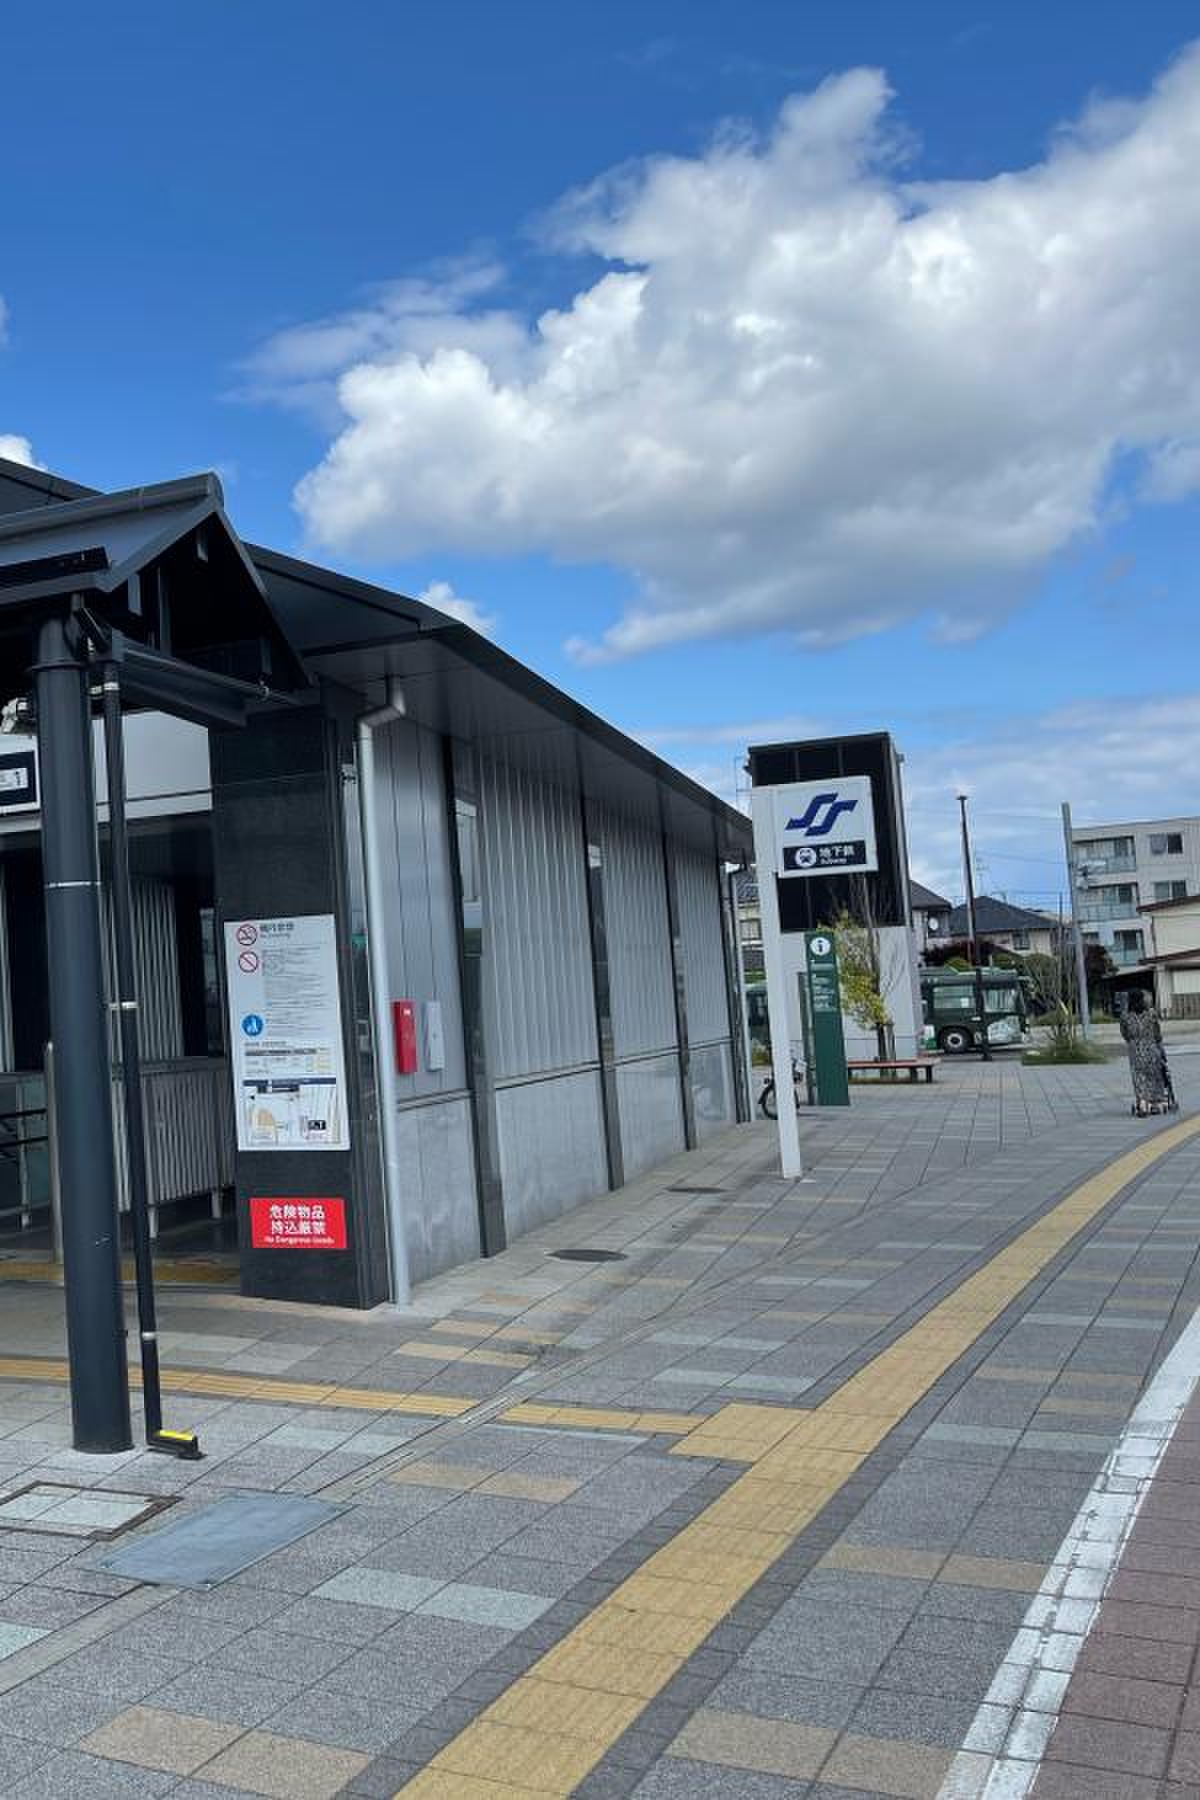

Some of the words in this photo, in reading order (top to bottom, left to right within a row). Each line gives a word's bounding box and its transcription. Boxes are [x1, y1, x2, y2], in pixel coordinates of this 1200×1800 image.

[819, 845, 855, 859] 地下鉄
[270, 1204, 325, 1219] 危険物品
[271, 1220, 326, 1234] 持込厳禁
